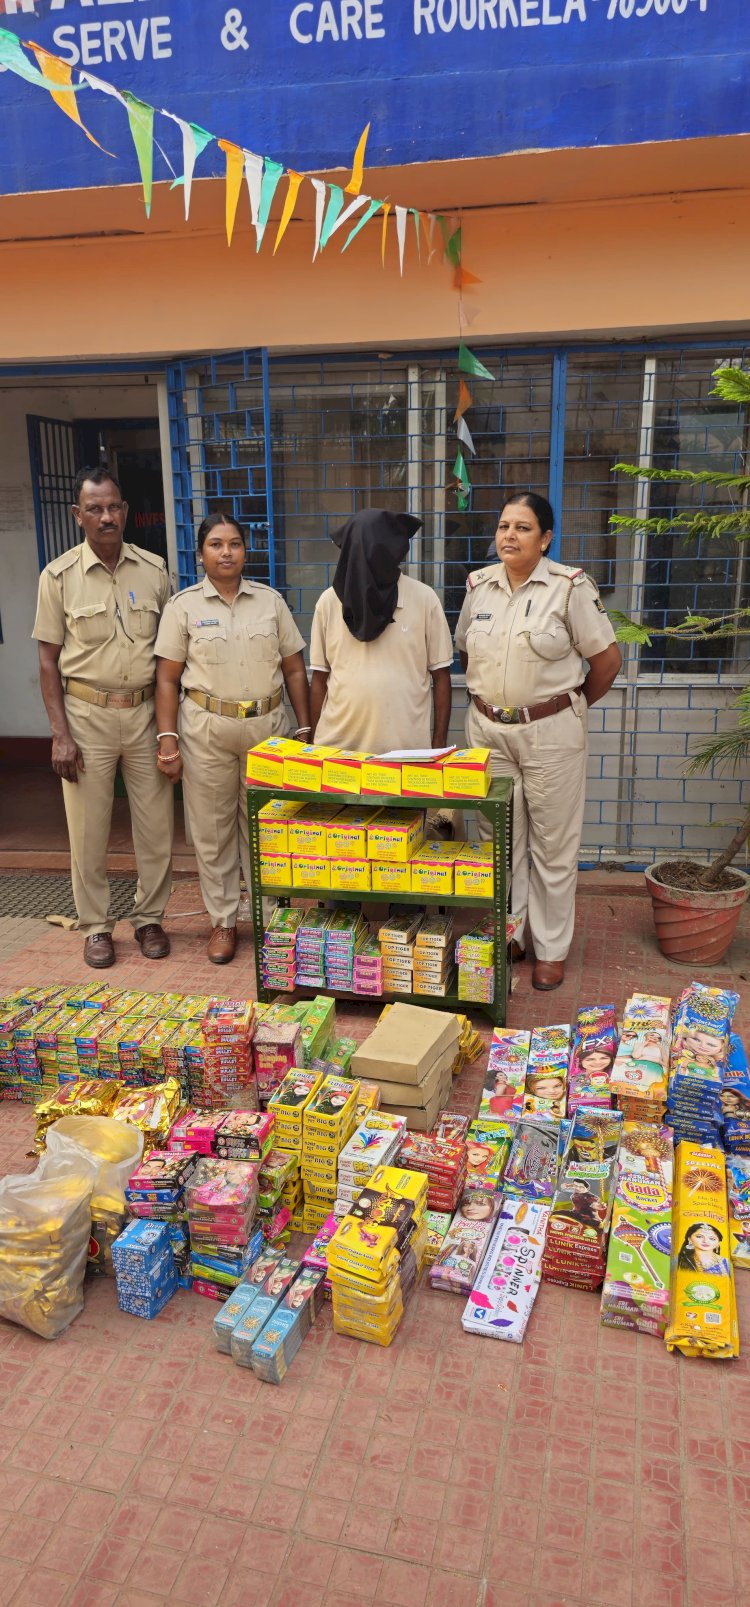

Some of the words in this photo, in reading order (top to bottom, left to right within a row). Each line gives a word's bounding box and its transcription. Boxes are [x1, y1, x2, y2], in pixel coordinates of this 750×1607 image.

[53, 16, 173, 66] SERVE
[220, 8, 250, 51] &
[289, 0, 386, 44] CARE
[327, 1080, 354, 1090] FLOWER
[476, 1128, 506, 1143] STAR
[353, 1161, 369, 1172] BIG
[685, 1160, 722, 1170] SPECIAL
[625, 1182, 660, 1196] Gada
[683, 1211, 725, 1223] Crackling
[550, 1239, 574, 1248] LUNIK
[575, 1244, 597, 1252] Express
[570, 1282, 592, 1290] LUNIK
[604, 1319, 634, 1328] HANUMAN
